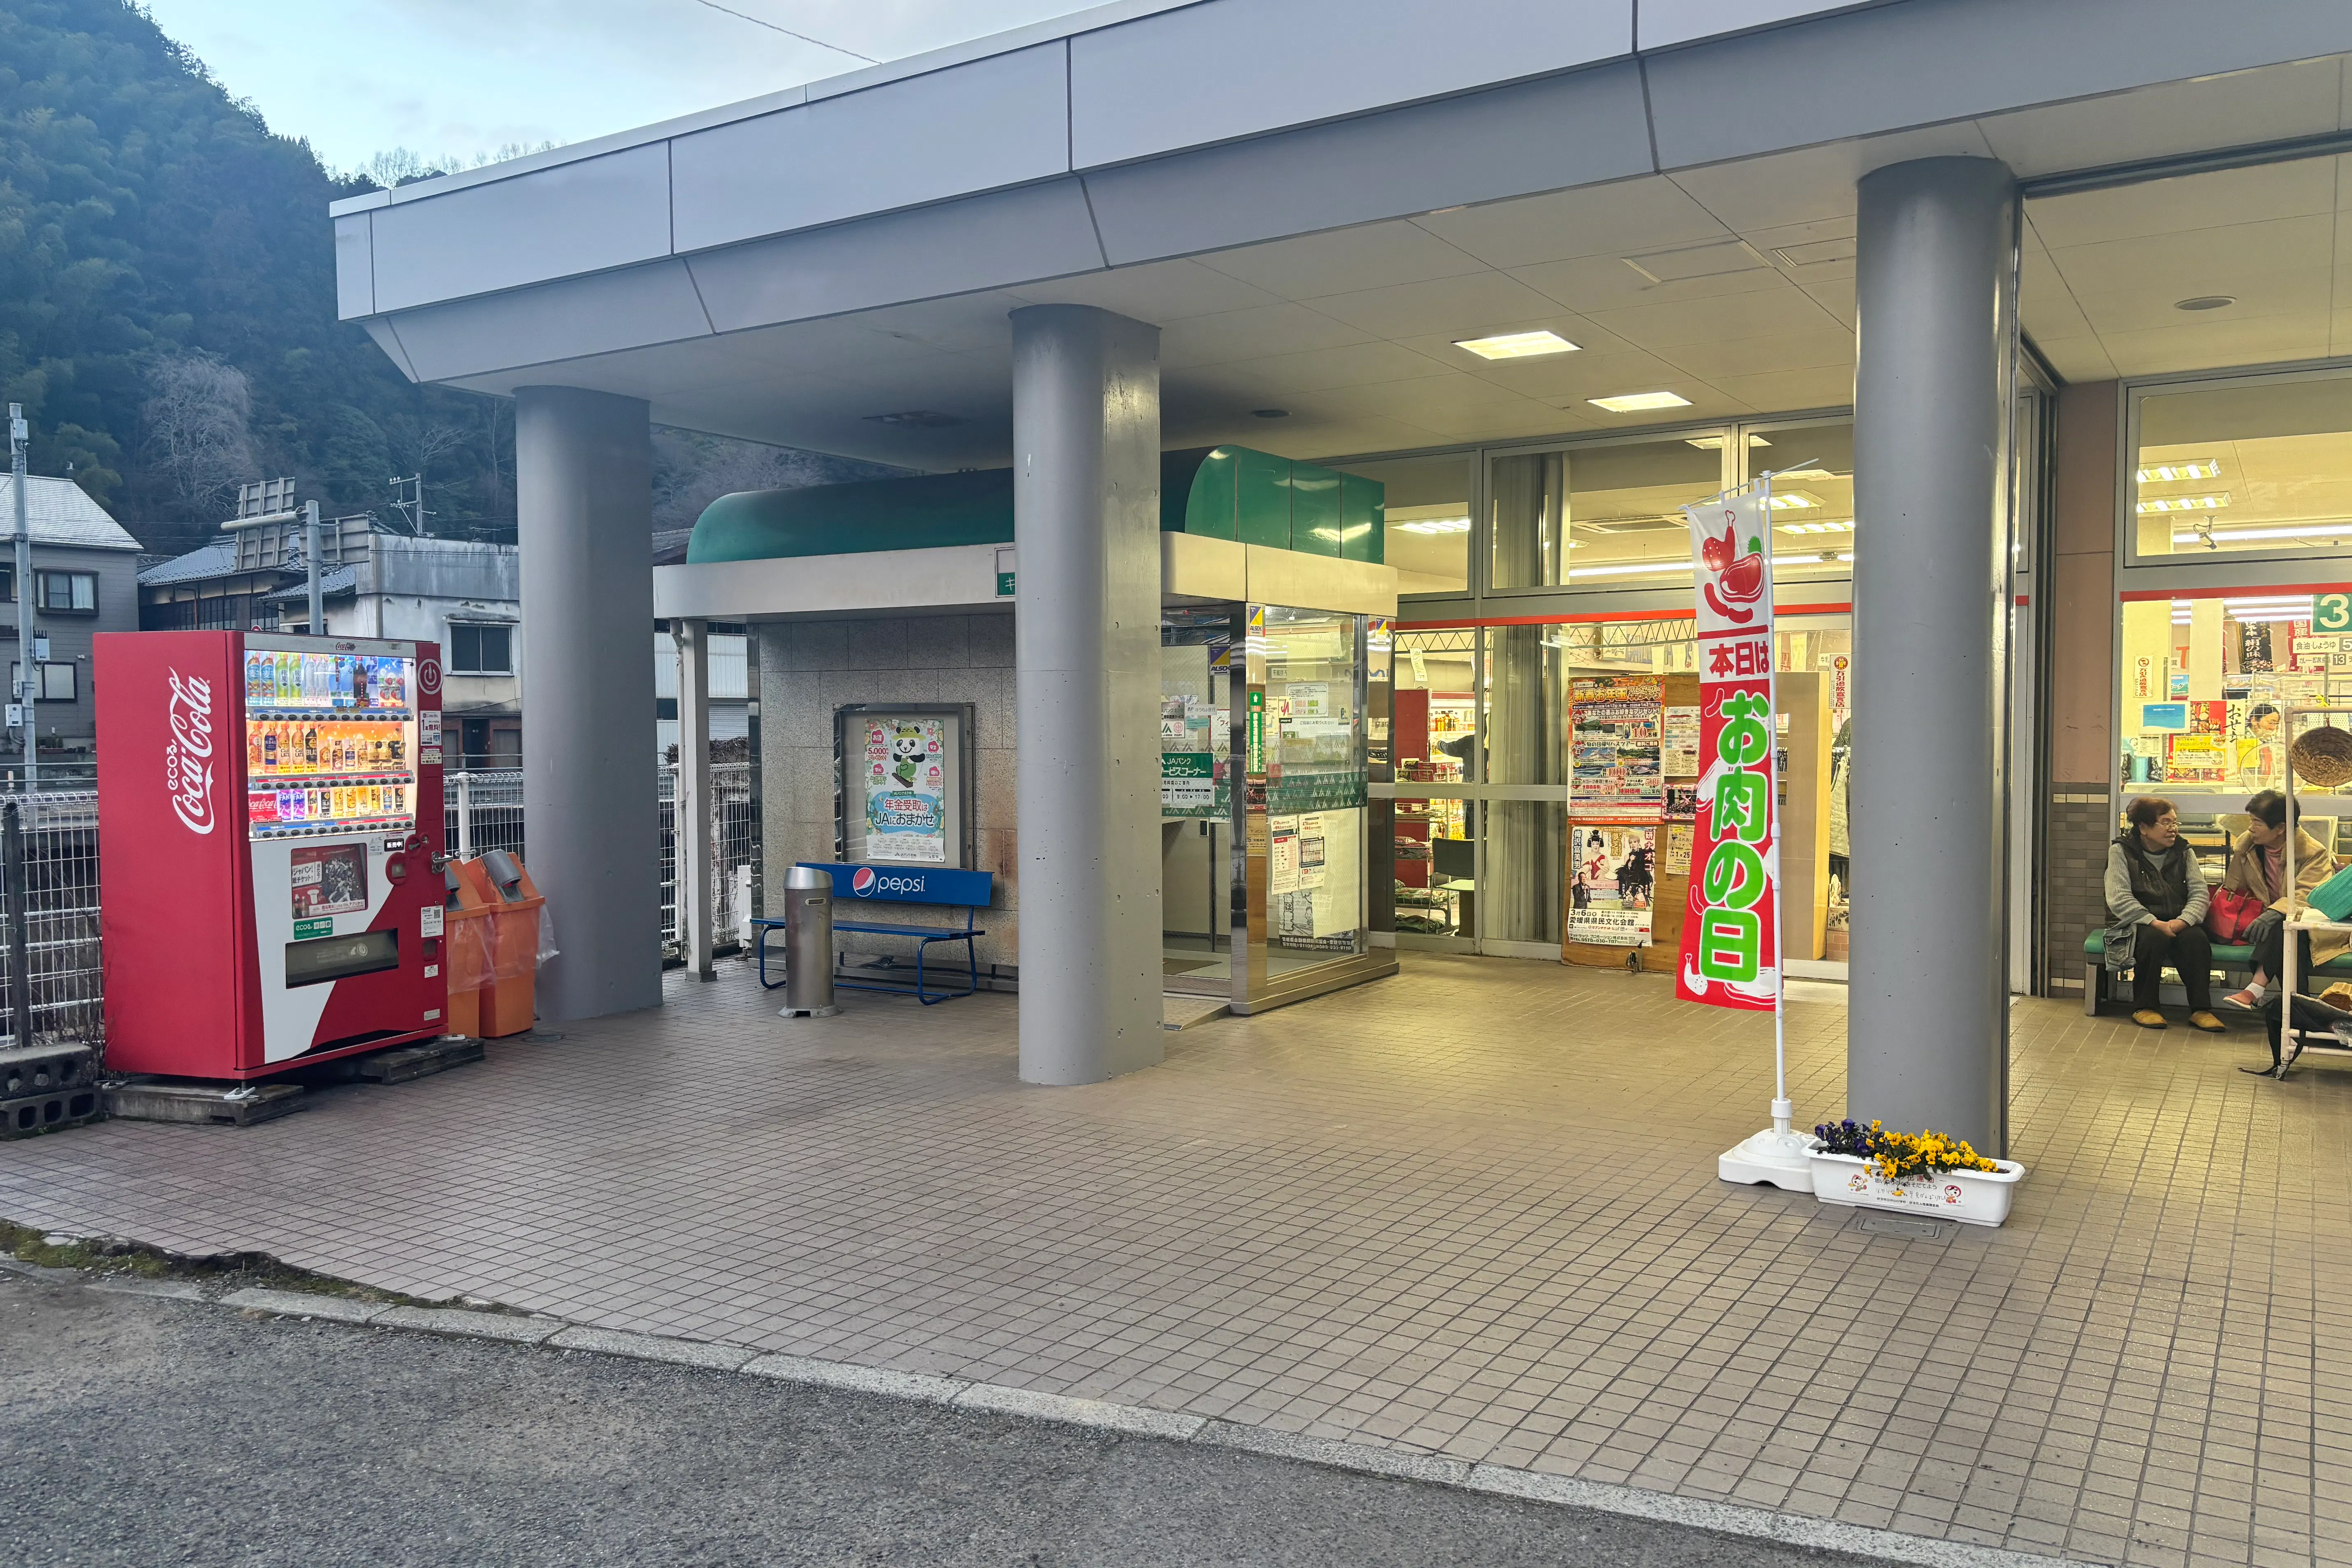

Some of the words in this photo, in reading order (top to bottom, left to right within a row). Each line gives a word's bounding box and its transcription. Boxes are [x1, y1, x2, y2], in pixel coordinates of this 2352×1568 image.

[2319, 594, 2350, 628] 3
[2343, 639, 2352, 651] 5
[1709, 639, 1769, 679] 本日は
[2333, 655, 2345, 665] 13
[168, 666, 214, 834] Coca-Cola
[1162, 767, 1206, 776] ービスコーナー
[884, 798, 928, 812] 年金受取は
[875, 812, 934, 826] JAにおまかせ
[1700, 690, 1769, 983] お肉の日
[1573, 829, 1582, 869] 梅沢富美男
[1645, 830, 1654, 871] 研ナオコ
[878, 875, 925, 895] pepsi
[1569, 916, 1635, 926] 愛媛県県民文化会館
